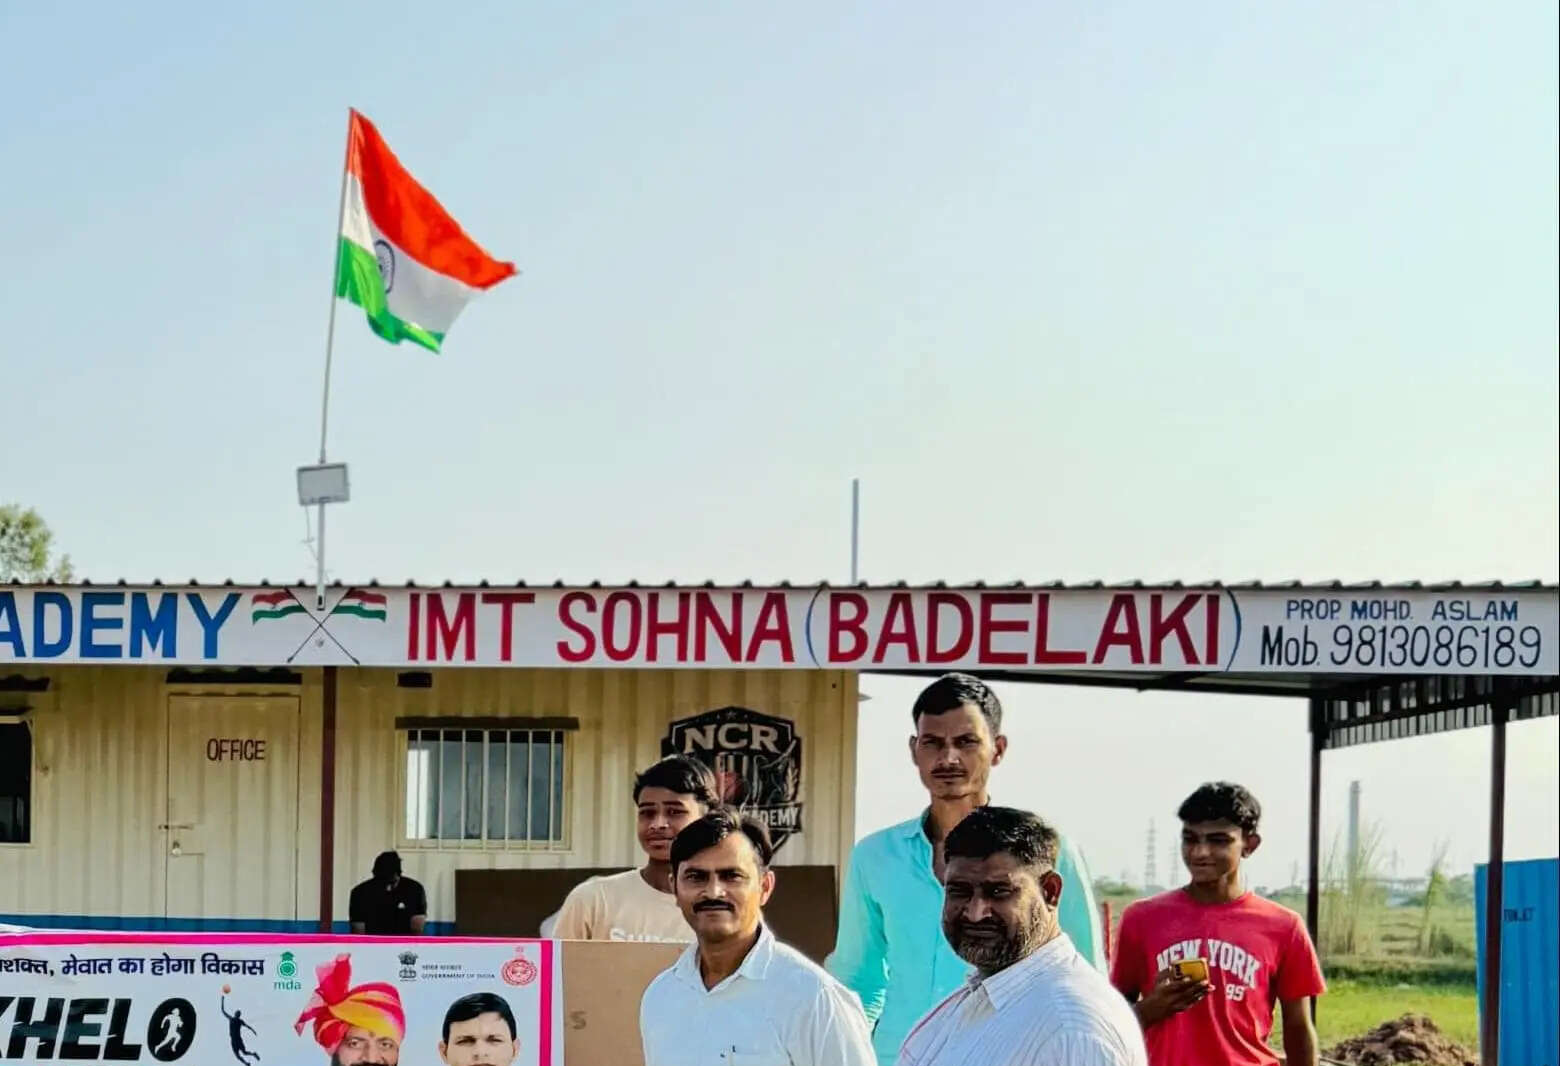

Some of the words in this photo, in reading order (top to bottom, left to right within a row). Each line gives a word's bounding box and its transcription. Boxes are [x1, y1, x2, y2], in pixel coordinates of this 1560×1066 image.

[1432, 601, 1519, 621] ASLAM
[407, 591, 536, 661] IMT
[556, 591, 795, 662] SOHNA
[1260, 625, 1320, 666] Mob.
[1330, 625, 1541, 668] 9813086189
[206, 738, 266, 761] OFFICE
[684, 723, 781, 754] NCR
[61, 954, 112, 975] मेवात
[118, 957, 145, 974] का
[151, 952, 195, 975] होगा
[201, 952, 265, 975] विकास
[1157, 938, 1202, 971] NEW
[1208, 938, 1261, 990] YORK
[274, 980, 302, 990] mda
[1226, 984, 1245, 1001] 95
